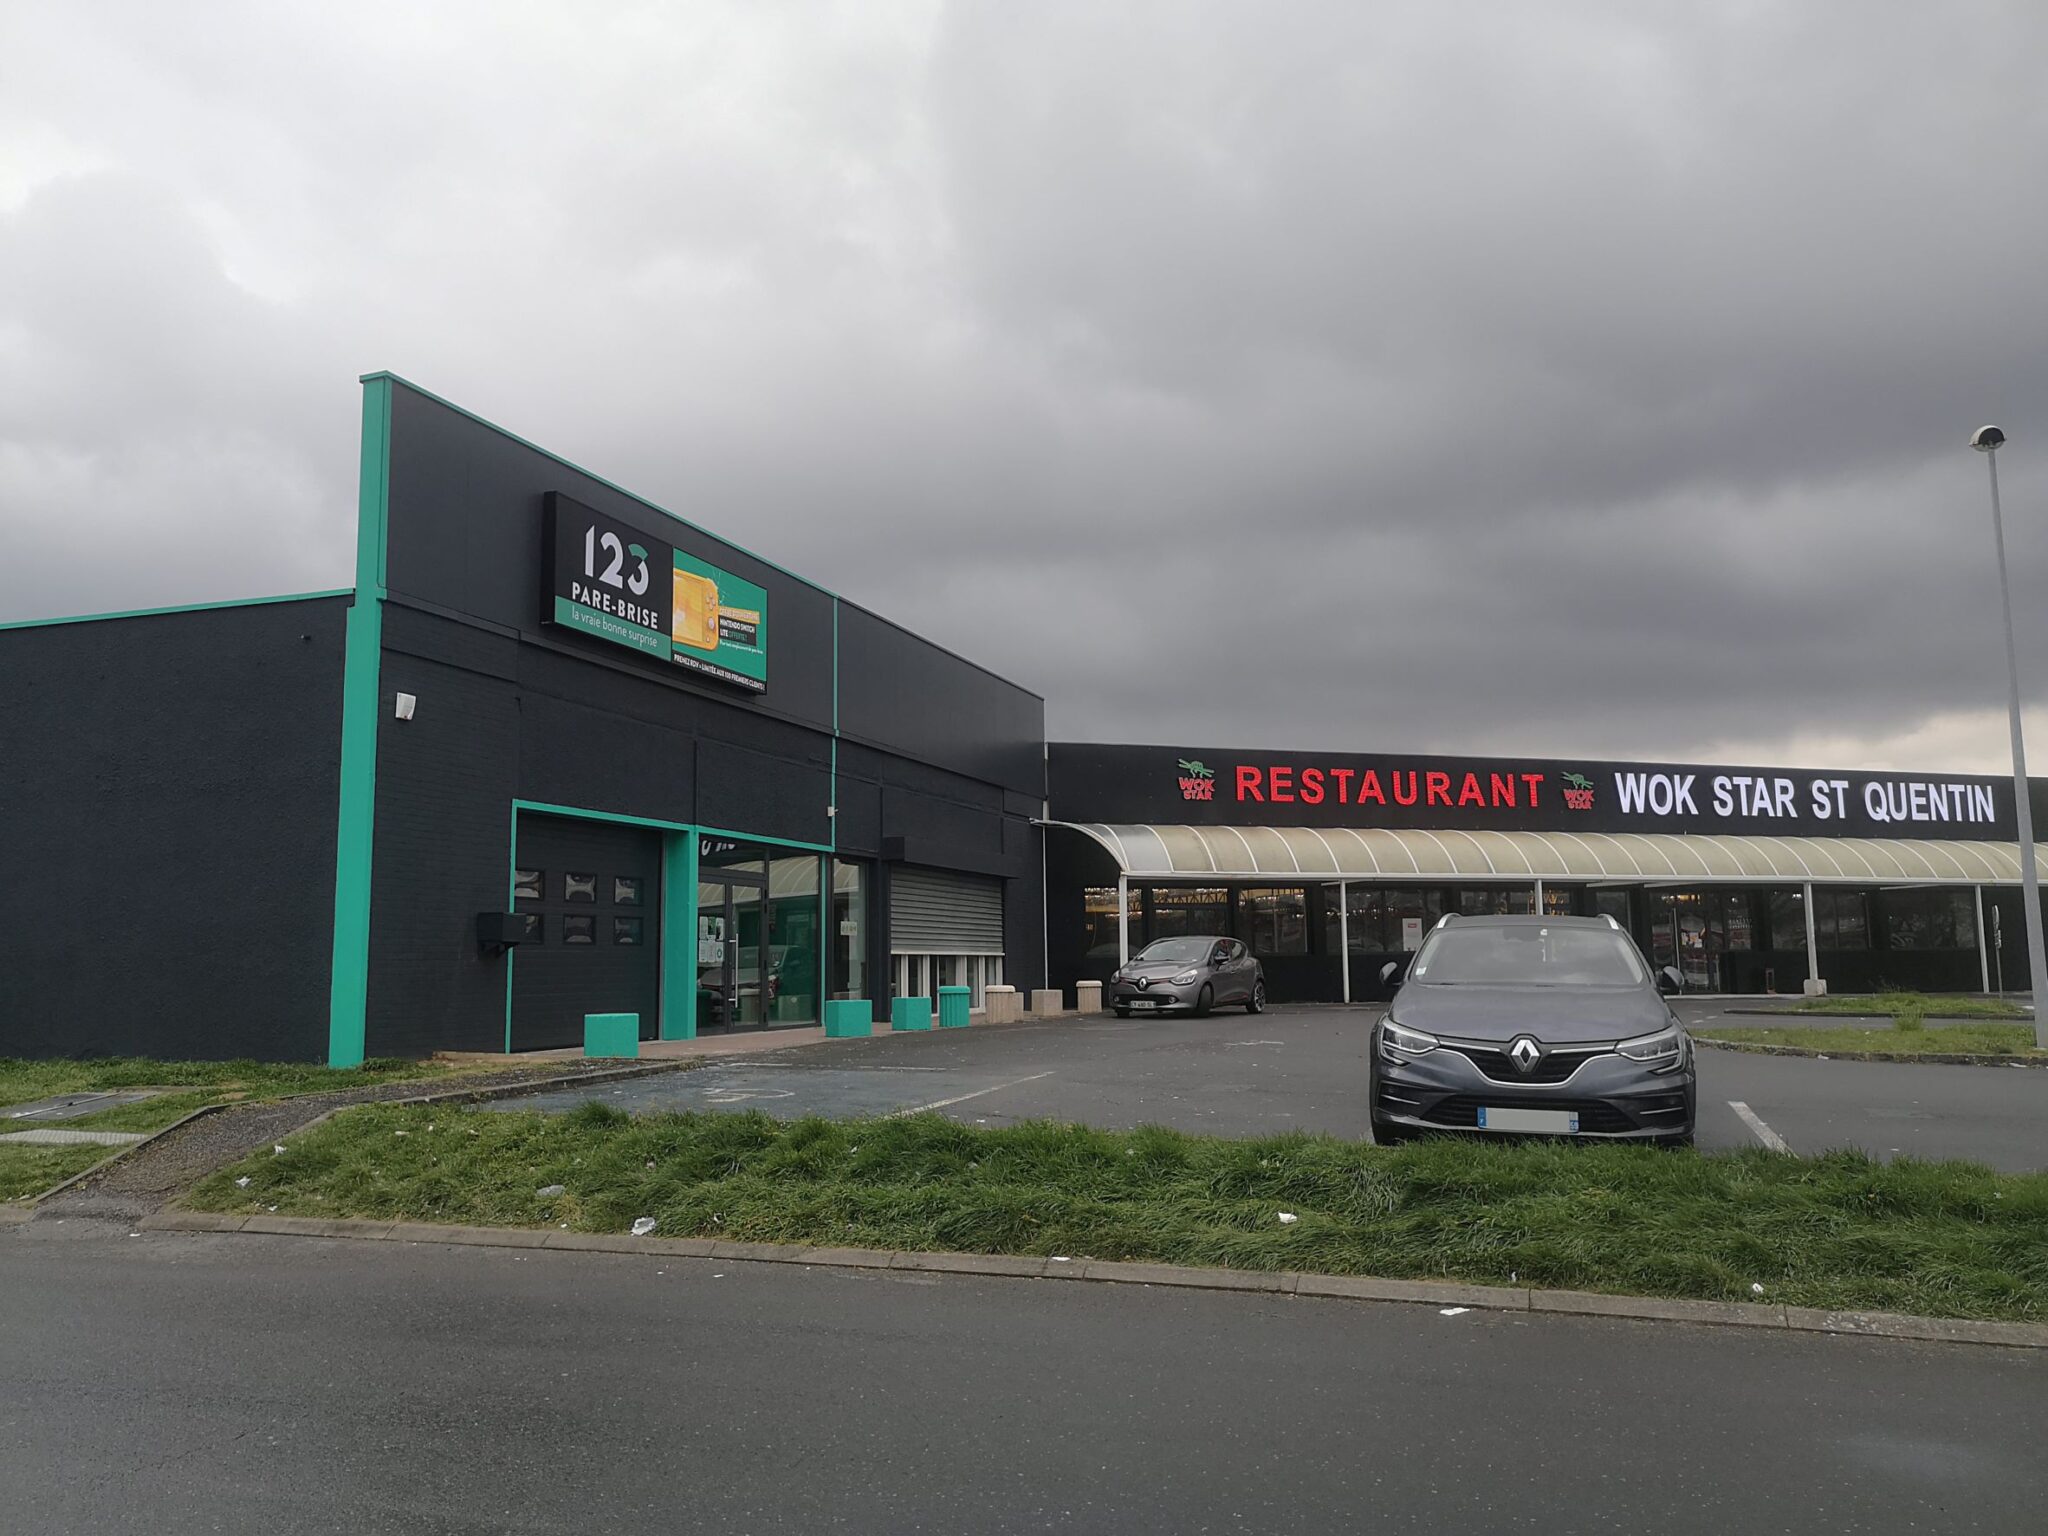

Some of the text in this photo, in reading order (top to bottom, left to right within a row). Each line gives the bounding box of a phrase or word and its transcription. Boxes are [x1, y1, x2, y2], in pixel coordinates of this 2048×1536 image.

[584, 525, 649, 596] 123
[572, 581, 658, 629] PARE-BRISE
[572, 605, 658, 648] la vraie bonne surprise
[1178, 776, 1215, 792] WOK
[1183, 789, 1213, 801] STAR
[1235, 765, 1544, 807] RESTAURANT
[1563, 788, 1595, 802] WOK
[1567, 800, 1592, 810] STAR
[1614, 772, 1996, 823] WOK STAR ST QUENTIN
